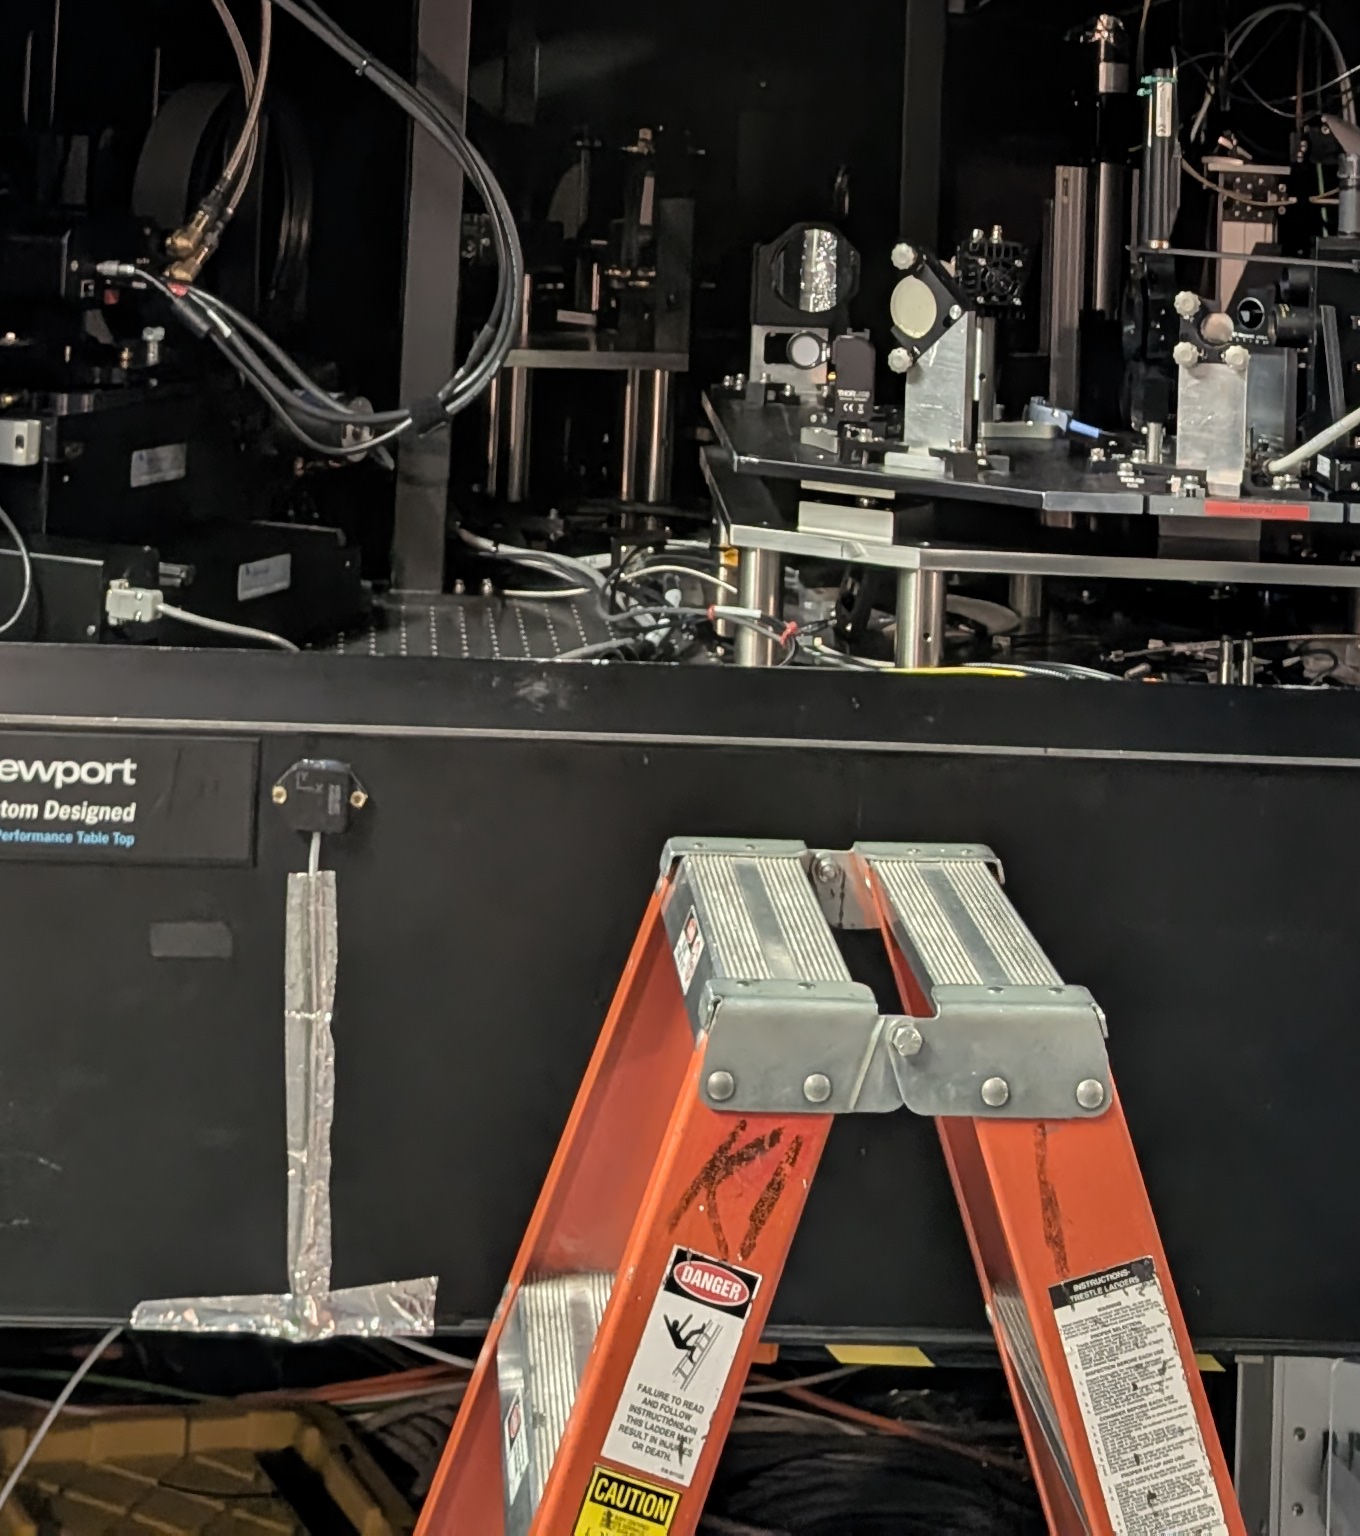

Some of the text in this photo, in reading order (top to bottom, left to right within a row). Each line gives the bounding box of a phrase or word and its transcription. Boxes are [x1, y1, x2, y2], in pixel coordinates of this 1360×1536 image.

[43, 799, 137, 825] Designed
[76, 830, 110, 844] Table
[112, 831, 135, 848] Top
[681, 1265, 742, 1301] DANGER
[637, 1383, 704, 1415] FAILURE TO READ
[641, 1397, 693, 1421] AND FOLLOW
[626, 1414, 644, 1427] THIS
[644, 1421, 675, 1438] LADDER
[629, 1404, 698, 1435] INSTRUCTIONS ON
[618, 1424, 648, 1441] RESULT
[649, 1435, 658, 1444] IN
[632, 1441, 671, 1461] OR DEATH.
[594, 1477, 670, 1521] CAUTION
